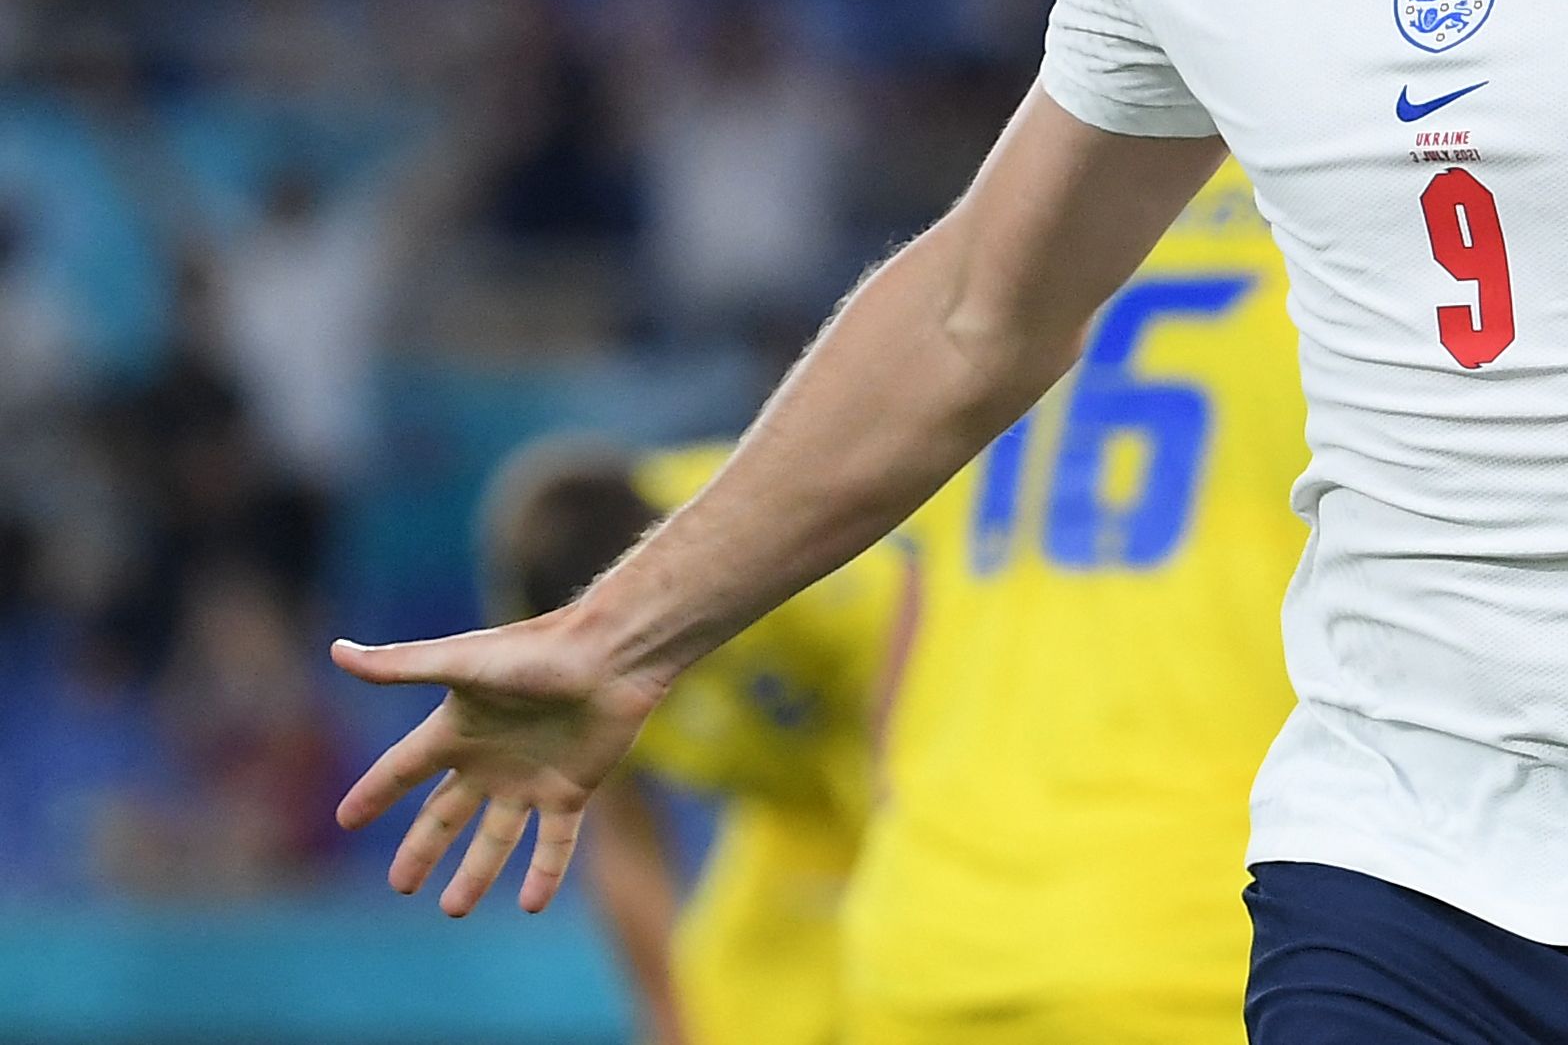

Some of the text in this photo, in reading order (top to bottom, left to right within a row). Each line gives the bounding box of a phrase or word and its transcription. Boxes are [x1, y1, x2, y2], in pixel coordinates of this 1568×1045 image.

[1416, 130, 1470, 146] UKRAINE
[1423, 149, 1451, 161] JULY
[1453, 148, 1481, 162] 2021
[1419, 166, 1515, 370] 9
[970, 275, 1257, 577] 16
